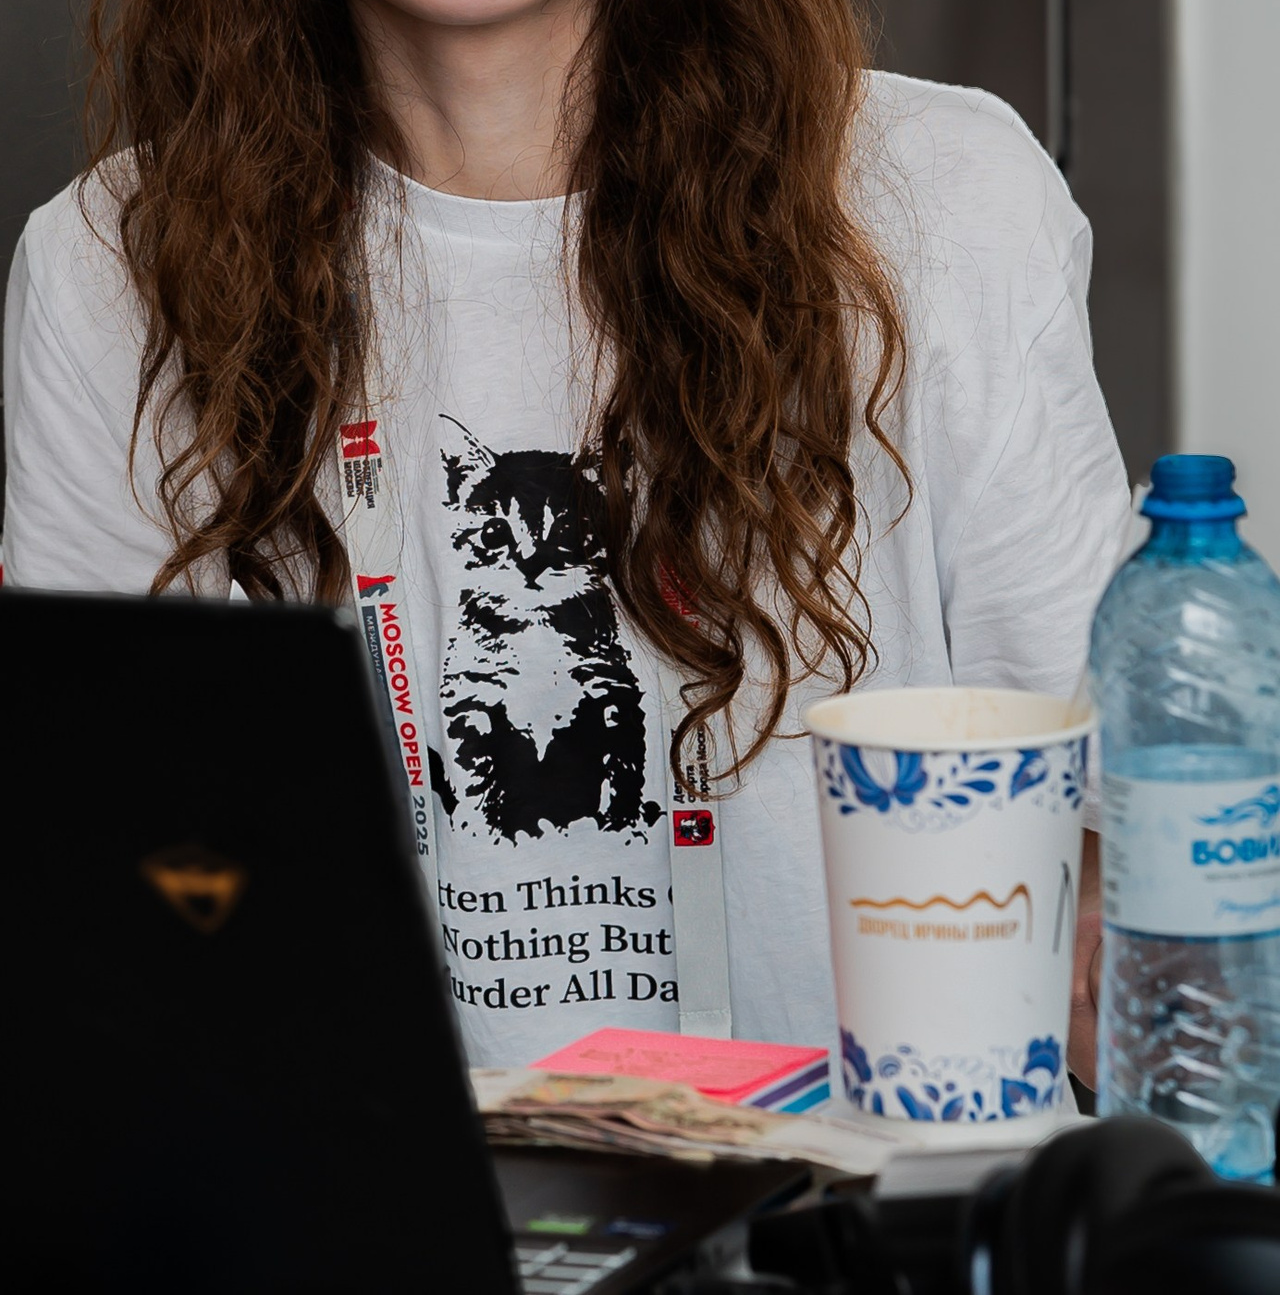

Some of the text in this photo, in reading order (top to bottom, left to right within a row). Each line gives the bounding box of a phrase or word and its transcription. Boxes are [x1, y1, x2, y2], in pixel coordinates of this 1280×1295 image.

[344, 461, 355, 498] МОСКВЫ
[379, 603, 429, 856] MOSCOW OPEN 2025
[438, 879, 508, 913] tten
[516, 875, 657, 911] Thinks
[441, 923, 672, 963] Nothing But
[450, 968, 679, 1009] urder All Da
